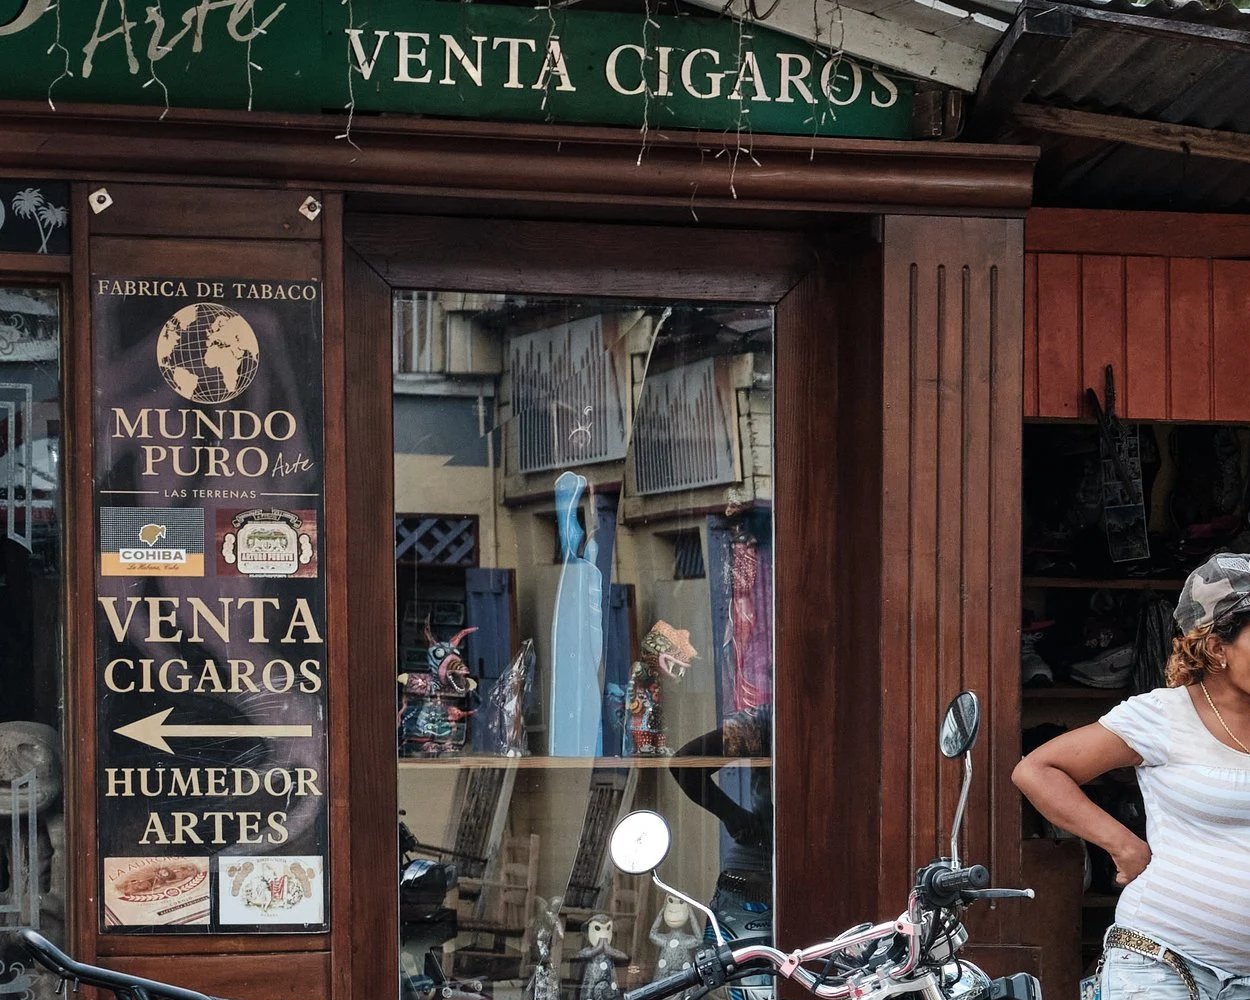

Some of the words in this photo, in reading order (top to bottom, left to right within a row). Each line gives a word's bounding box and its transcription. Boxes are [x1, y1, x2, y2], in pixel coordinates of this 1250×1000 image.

[345, 28, 577, 92] VENTA
[604, 44, 899, 108] CIGAROS
[98, 279, 188, 297] FABRICA
[196, 282, 225, 298] DE
[233, 283, 317, 300] TABACO
[111, 407, 297, 440] MUNDO
[140, 445, 269, 477] PURO
[271, 452, 314, 477] Arte
[164, 489, 187, 498] LAS
[192, 489, 257, 499] TERRENAS
[121, 550, 184, 561] COHIBA
[98, 597, 323, 643] VENTA
[104, 659, 322, 694] CIGAROS
[105, 767, 322, 797] HUMEDOR
[138, 811, 289, 845] ARTES
